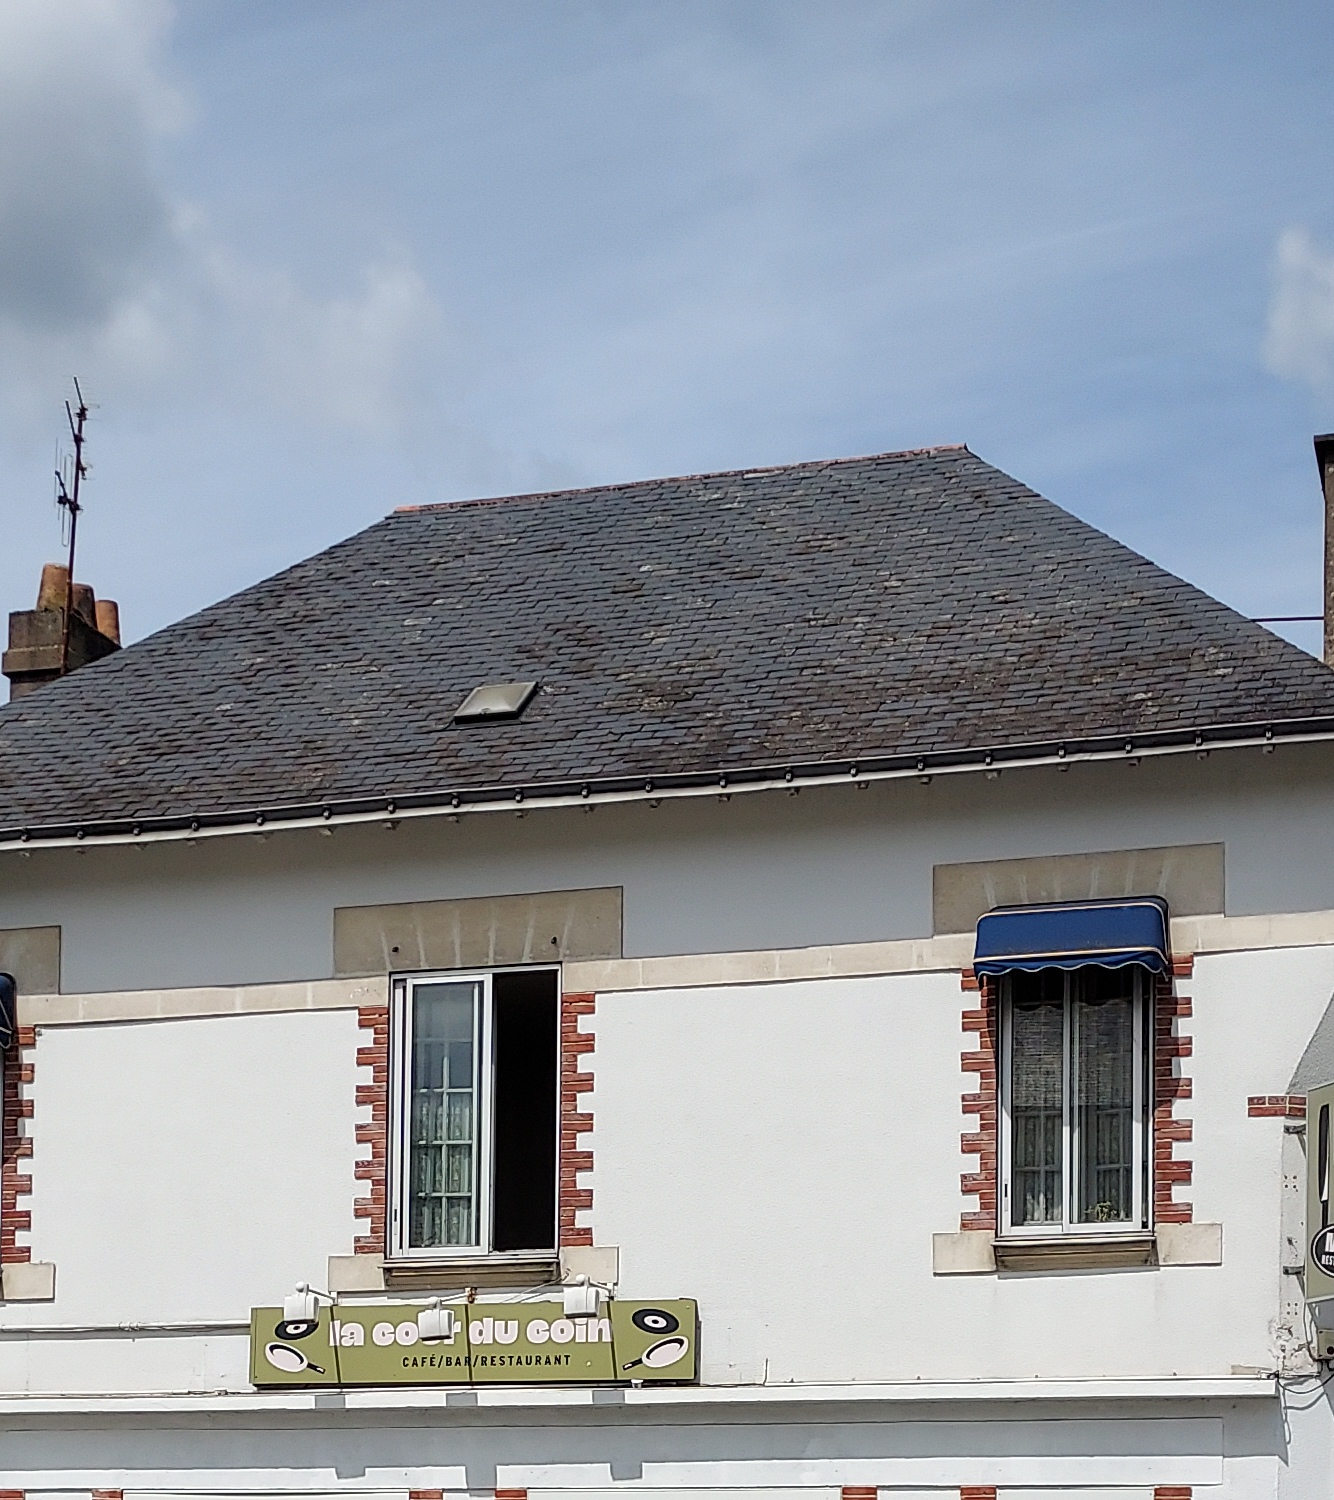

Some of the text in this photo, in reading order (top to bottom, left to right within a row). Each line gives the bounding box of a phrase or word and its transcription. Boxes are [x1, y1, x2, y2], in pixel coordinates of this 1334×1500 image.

[328, 1319, 365, 1347] la
[468, 1317, 519, 1345] du
[526, 1317, 613, 1344] coin
